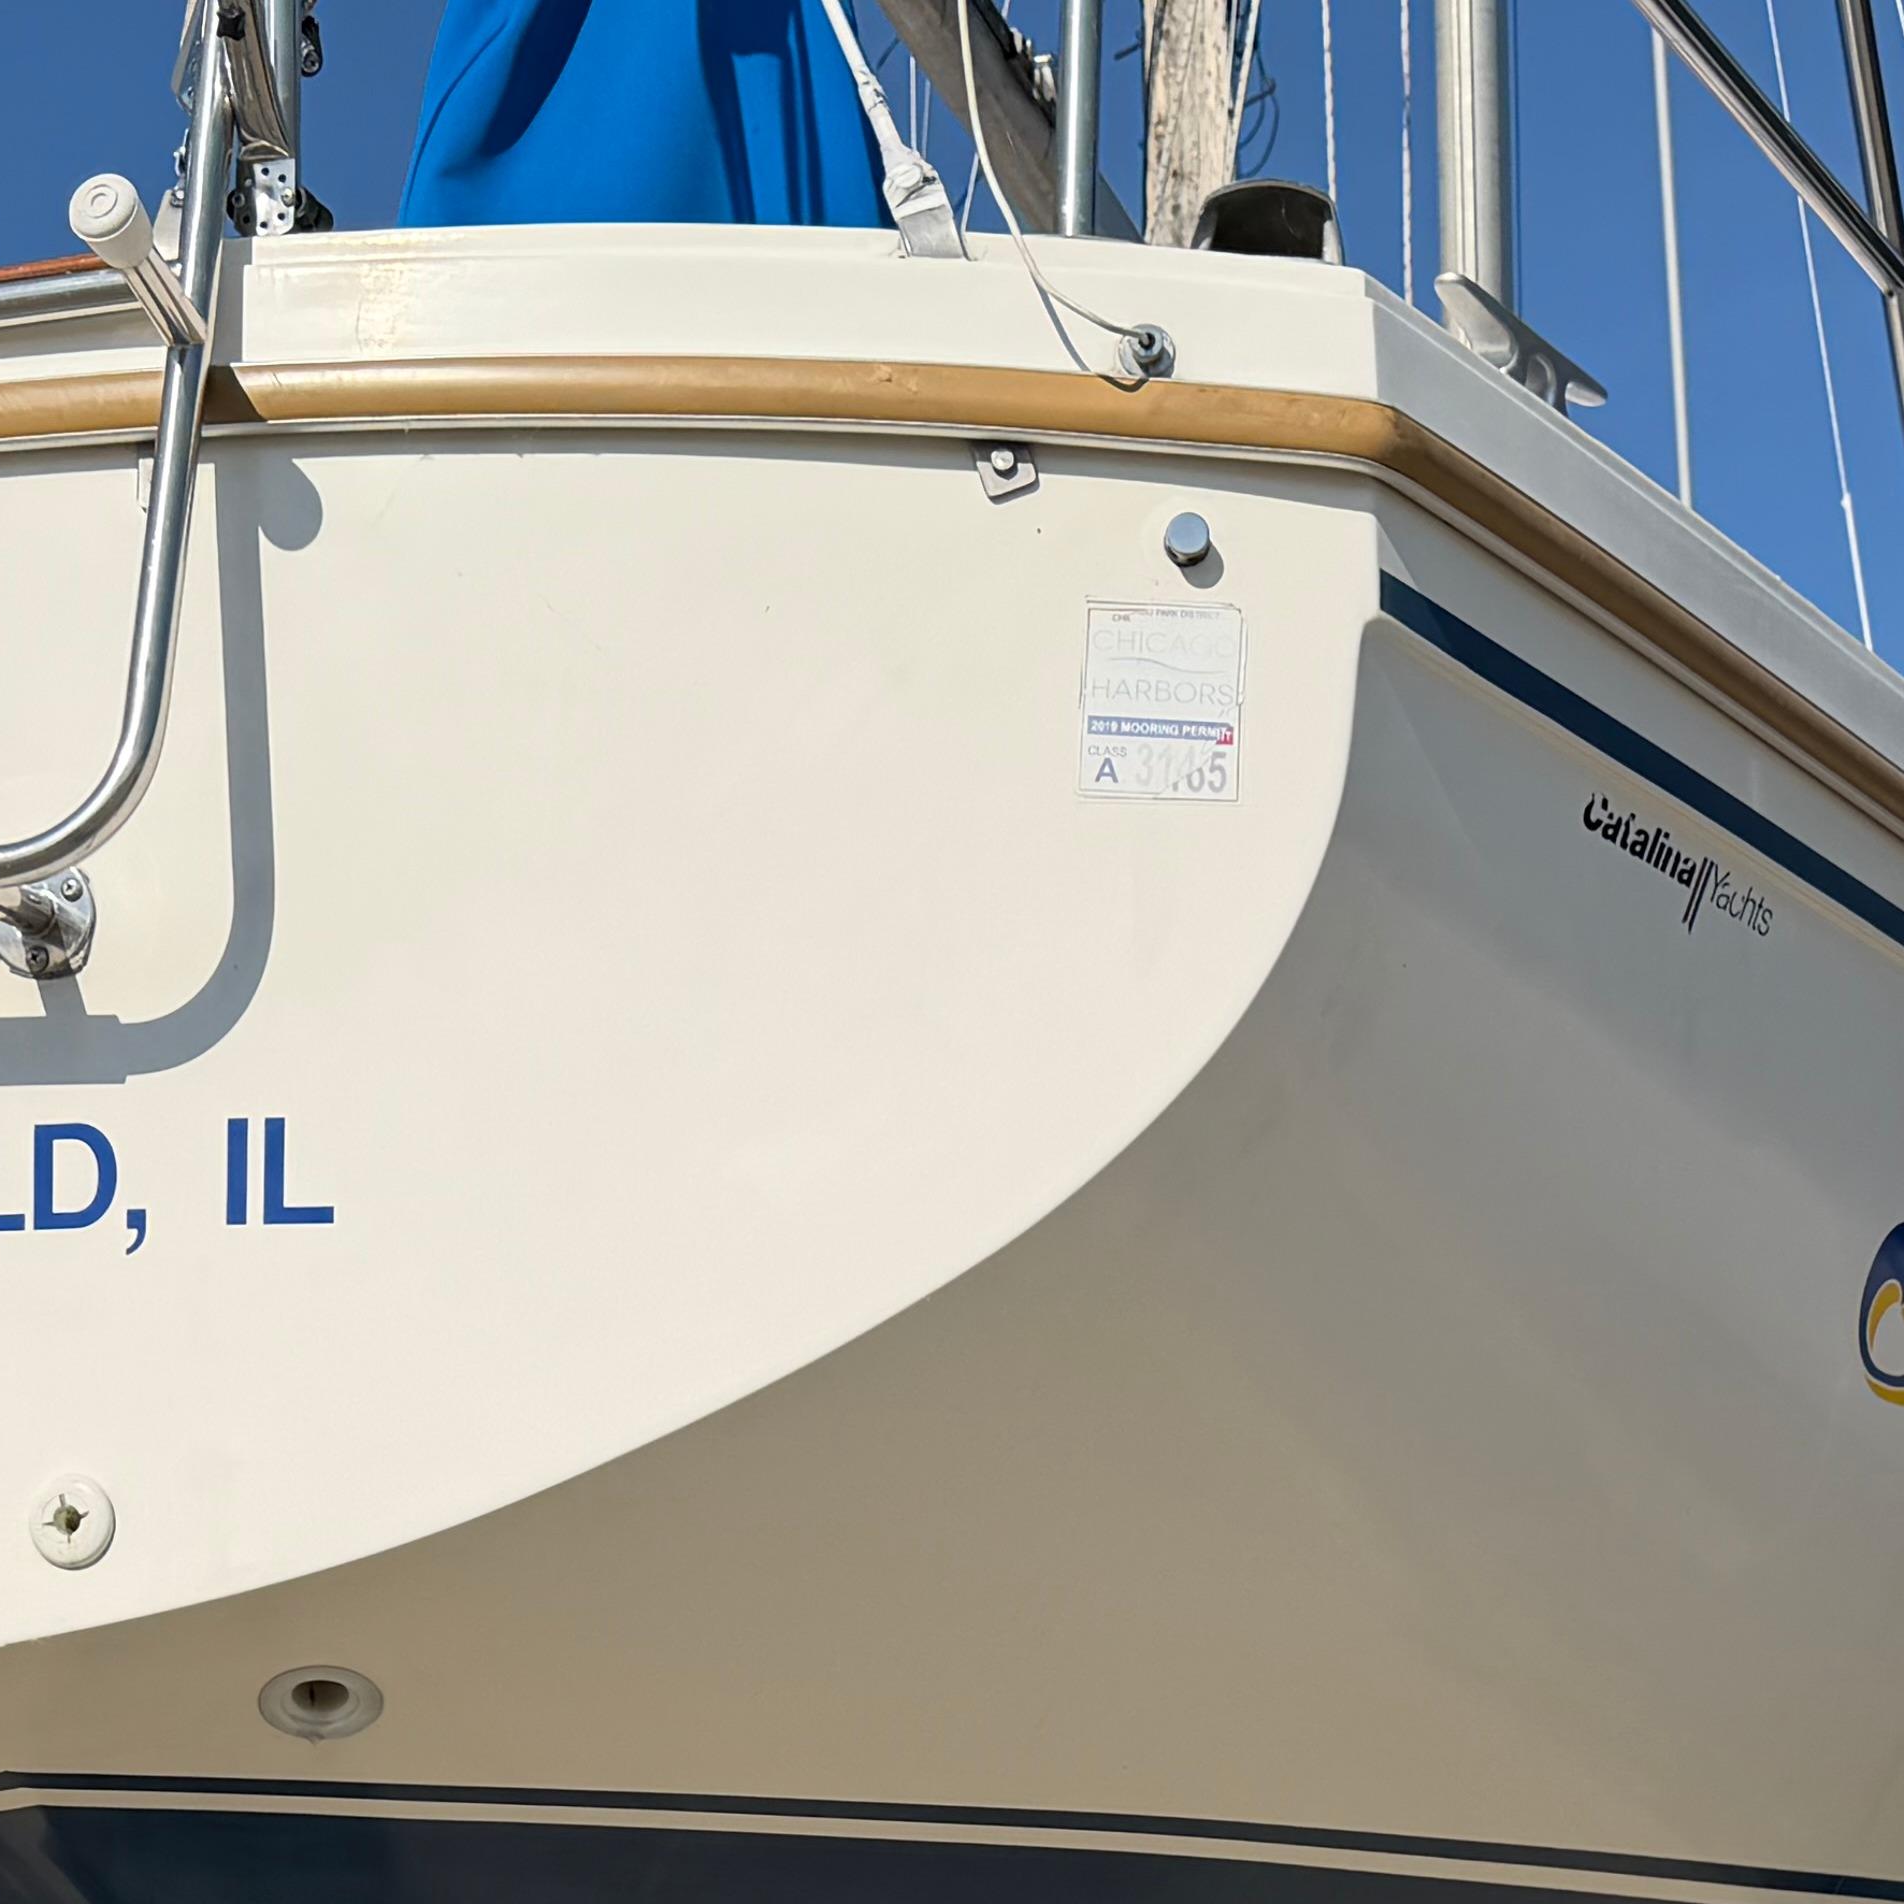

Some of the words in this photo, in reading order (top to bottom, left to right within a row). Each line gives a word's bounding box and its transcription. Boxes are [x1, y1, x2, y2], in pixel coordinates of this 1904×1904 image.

[1093, 628, 1237, 658] CHICAGO
[1092, 674, 1235, 707] HARBORS
[1121, 721, 1179, 737] MOORING
[1088, 744, 1128, 758] CLASS
[1094, 757, 1120, 784] A
[1583, 793, 1698, 889] Catalina
[1709, 864, 1774, 937] Yachts
[226, 1116, 335, 1226] IL
